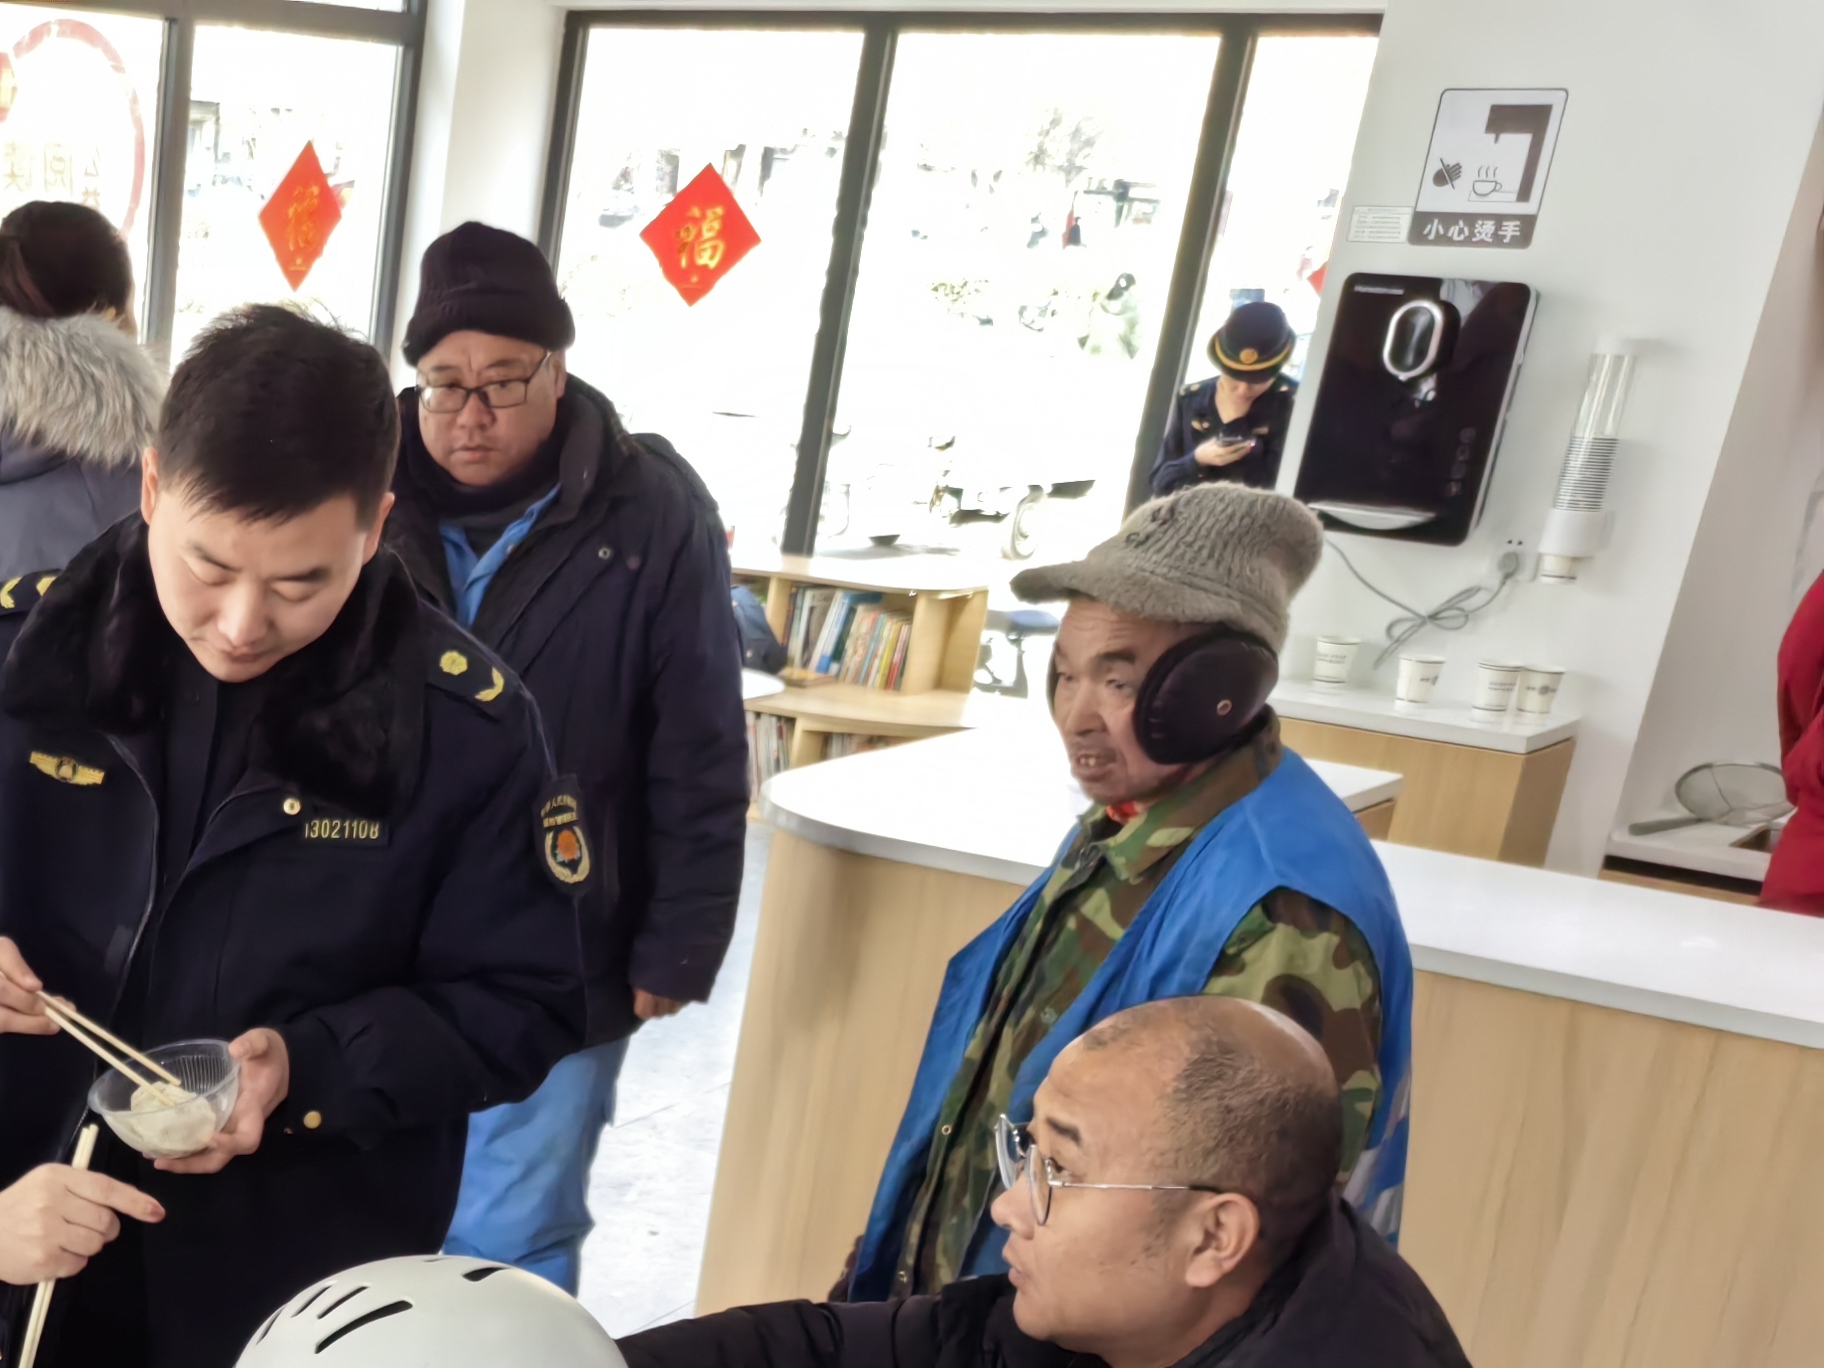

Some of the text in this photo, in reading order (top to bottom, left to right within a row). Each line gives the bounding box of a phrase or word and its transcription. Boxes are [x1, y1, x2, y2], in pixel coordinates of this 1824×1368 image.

[674, 205, 726, 270] 福
[1423, 218, 1522, 244] 小心烫手
